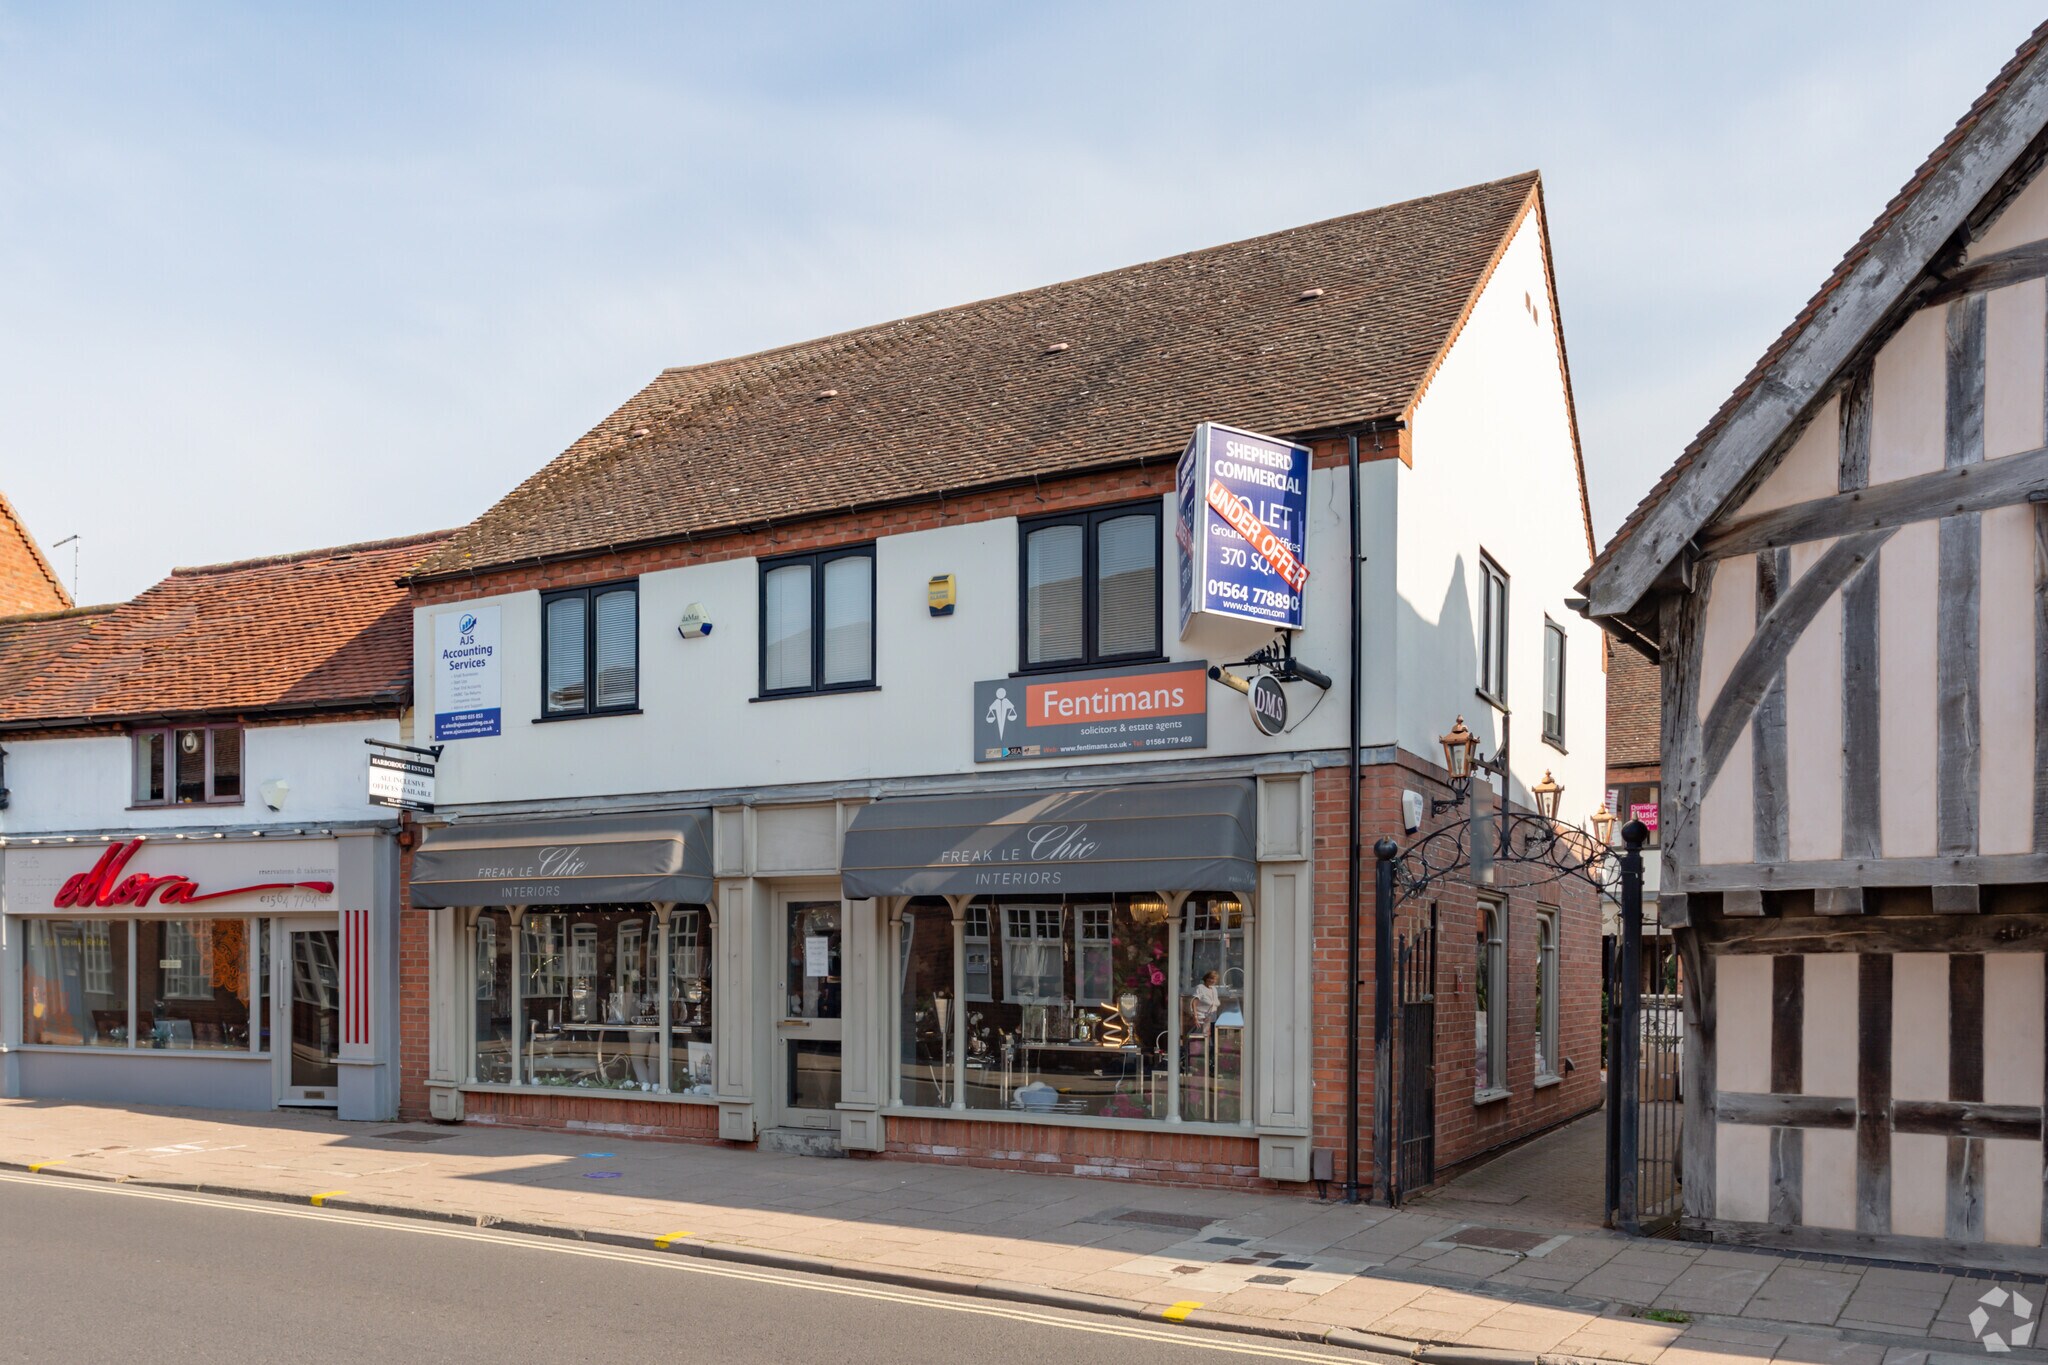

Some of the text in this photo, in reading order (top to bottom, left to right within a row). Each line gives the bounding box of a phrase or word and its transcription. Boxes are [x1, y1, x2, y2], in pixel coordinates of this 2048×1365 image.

[1226, 440, 1294, 471] SHEPHERD
[1214, 459, 1302, 495] COMMERCIAL
[1260, 500, 1293, 530] LET
[1209, 482, 1261, 543] UNDER
[1261, 534, 1308, 590] OFFER
[1210, 523, 1246, 541] Groun
[1220, 546, 1247, 568] 370
[1208, 579, 1249, 602] 01564
[1252, 587, 1299, 611] 778890
[1222, 600, 1286, 619] www.shepcom.com
[459, 635, 475, 645] AJS
[442, 645, 493, 659] Accounting
[449, 658, 486, 671] Services
[1044, 687, 1185, 718] Fentimans
[1256, 686, 1284, 721] DMS
[1080, 721, 1183, 736] solicitors & estate agents
[1060, 741, 1128, 752] www.fentimans.co.uk
[372, 757, 434, 774] HARBOROUGH ESTATES
[372, 783, 432, 797] OFFICES AVAILABLE
[393, 775, 425, 788] INCLUSIVE
[1630, 804, 1657, 813] Dorridge
[941, 823, 1102, 863] FREAK LE Chic
[477, 847, 588, 878] FREAK LE Chic
[259, 868, 295, 876] reservations
[975, 872, 1062, 885] INTERIORS
[501, 885, 560, 897] INTERIORS
